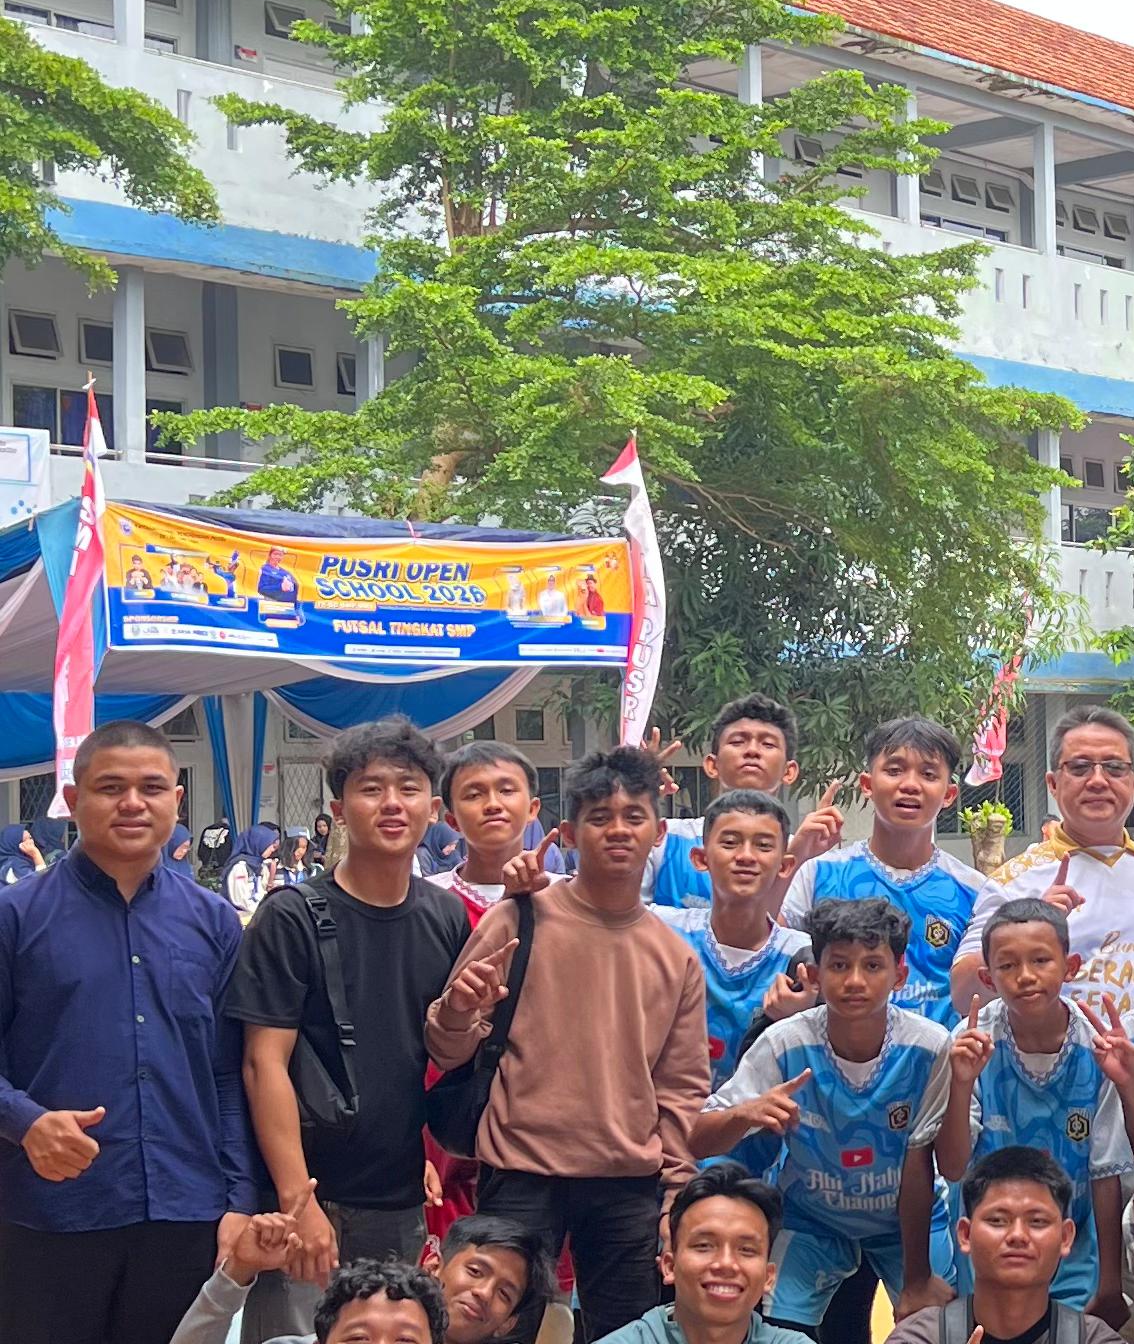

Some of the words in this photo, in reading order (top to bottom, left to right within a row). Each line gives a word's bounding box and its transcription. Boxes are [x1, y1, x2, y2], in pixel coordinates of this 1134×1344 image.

[319, 554, 401, 582] PUSRI
[405, 561, 473, 583] OPEN
[314, 577, 423, 602] SCHOOL
[422, 584, 488, 606] 2026
[332, 619, 387, 636] FUTSAL
[389, 621, 445, 637] TINGKAT
[446, 623, 477, 638] SMP
[623, 617, 656, 722] PUSR
[822, 1190, 898, 1213] Channe
